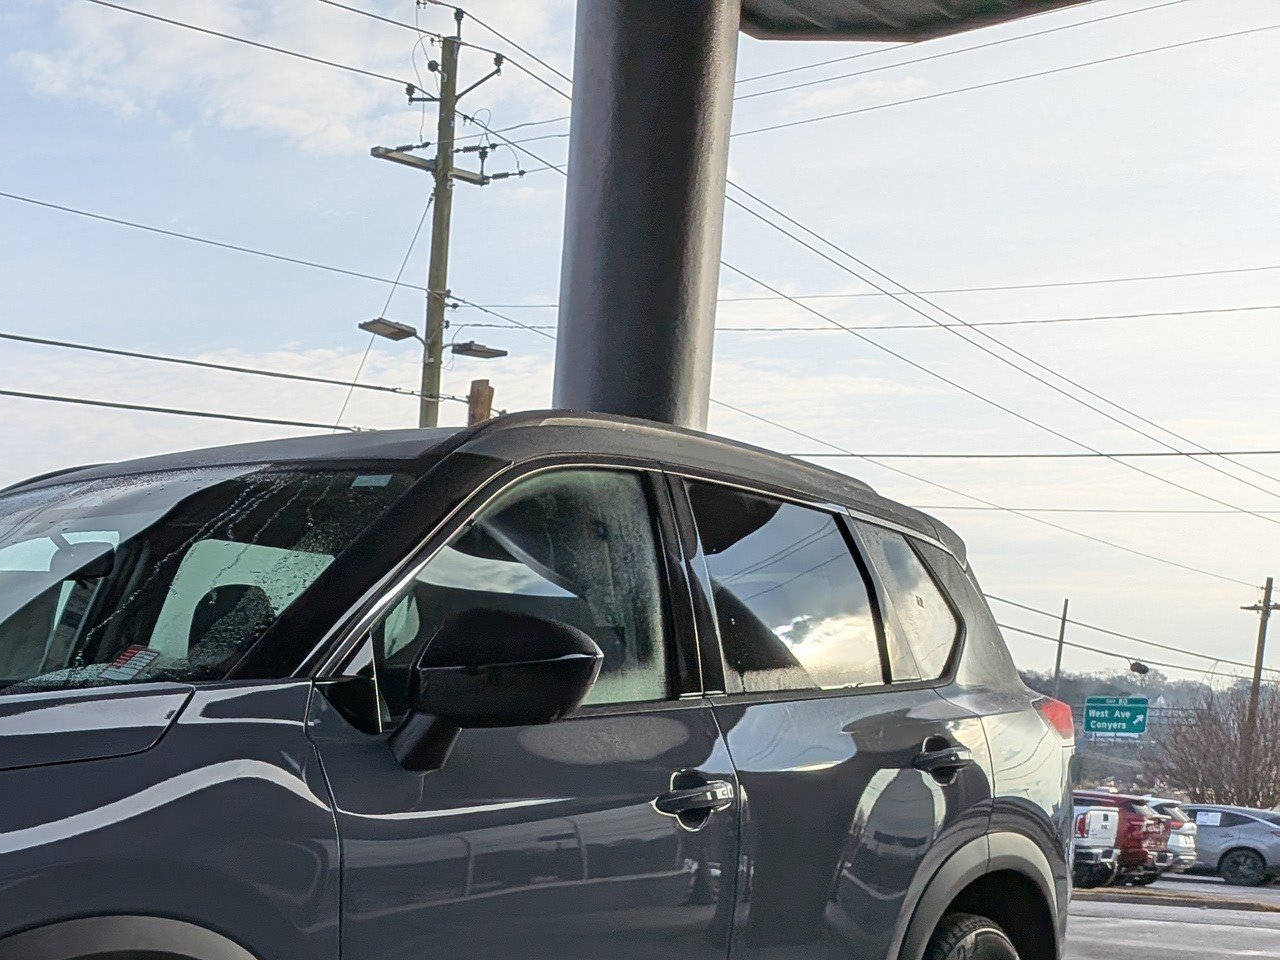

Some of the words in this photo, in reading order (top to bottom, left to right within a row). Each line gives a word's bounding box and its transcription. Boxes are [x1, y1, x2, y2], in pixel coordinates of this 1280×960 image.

[1088, 709, 1108, 718] West
[1113, 709, 1131, 718] Ave
[1090, 720, 1127, 730] Conyers
